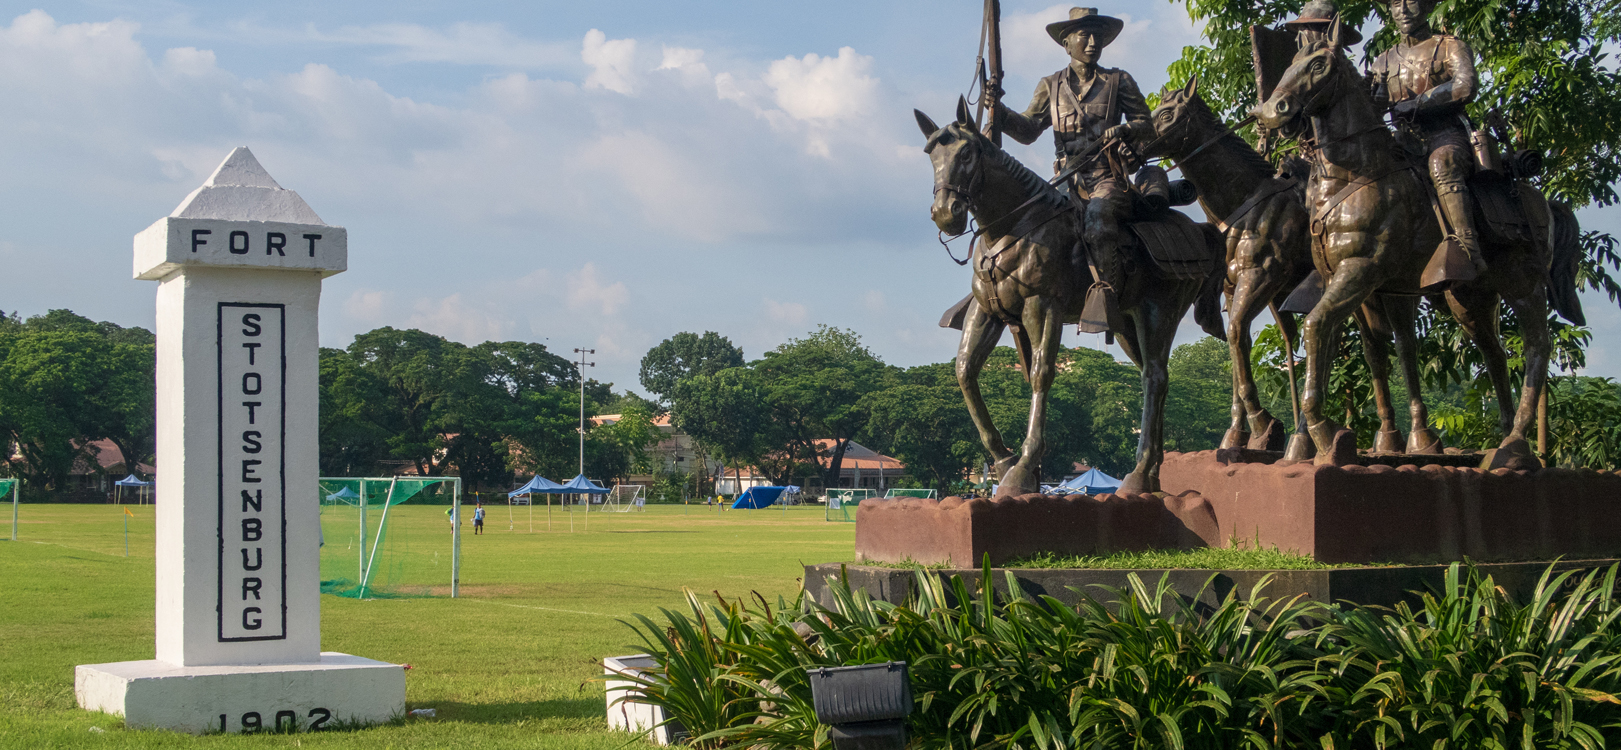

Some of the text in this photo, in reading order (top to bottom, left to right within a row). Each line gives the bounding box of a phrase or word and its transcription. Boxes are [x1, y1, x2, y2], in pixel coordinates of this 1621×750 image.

[191, 229, 323, 258] FORT
[241, 313, 263, 631] STOTSENBURG
[219, 707, 331, 735] 1902
